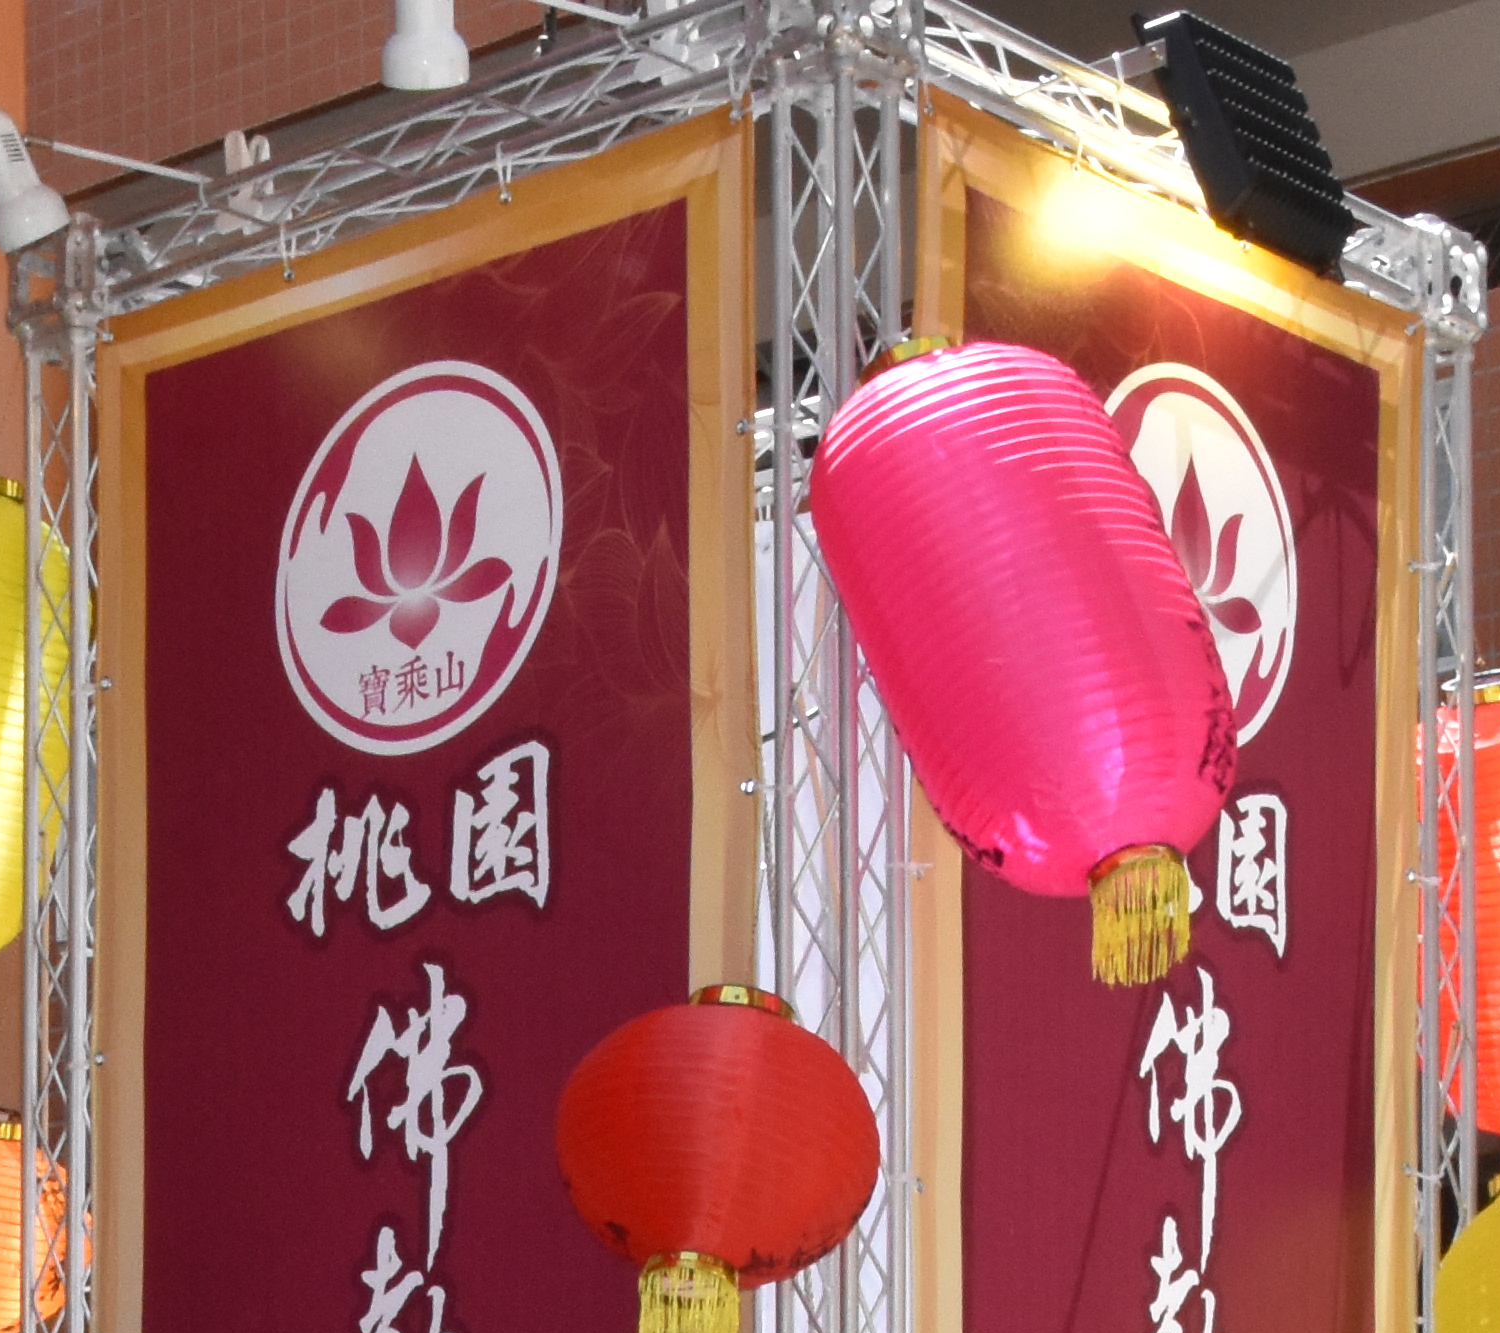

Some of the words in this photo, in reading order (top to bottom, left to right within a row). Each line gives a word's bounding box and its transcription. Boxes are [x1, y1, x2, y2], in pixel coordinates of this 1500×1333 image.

[357, 650, 468, 720] 寶乘山
[286, 738, 553, 938] 桃園
[1182, 792, 1289, 960] 園
